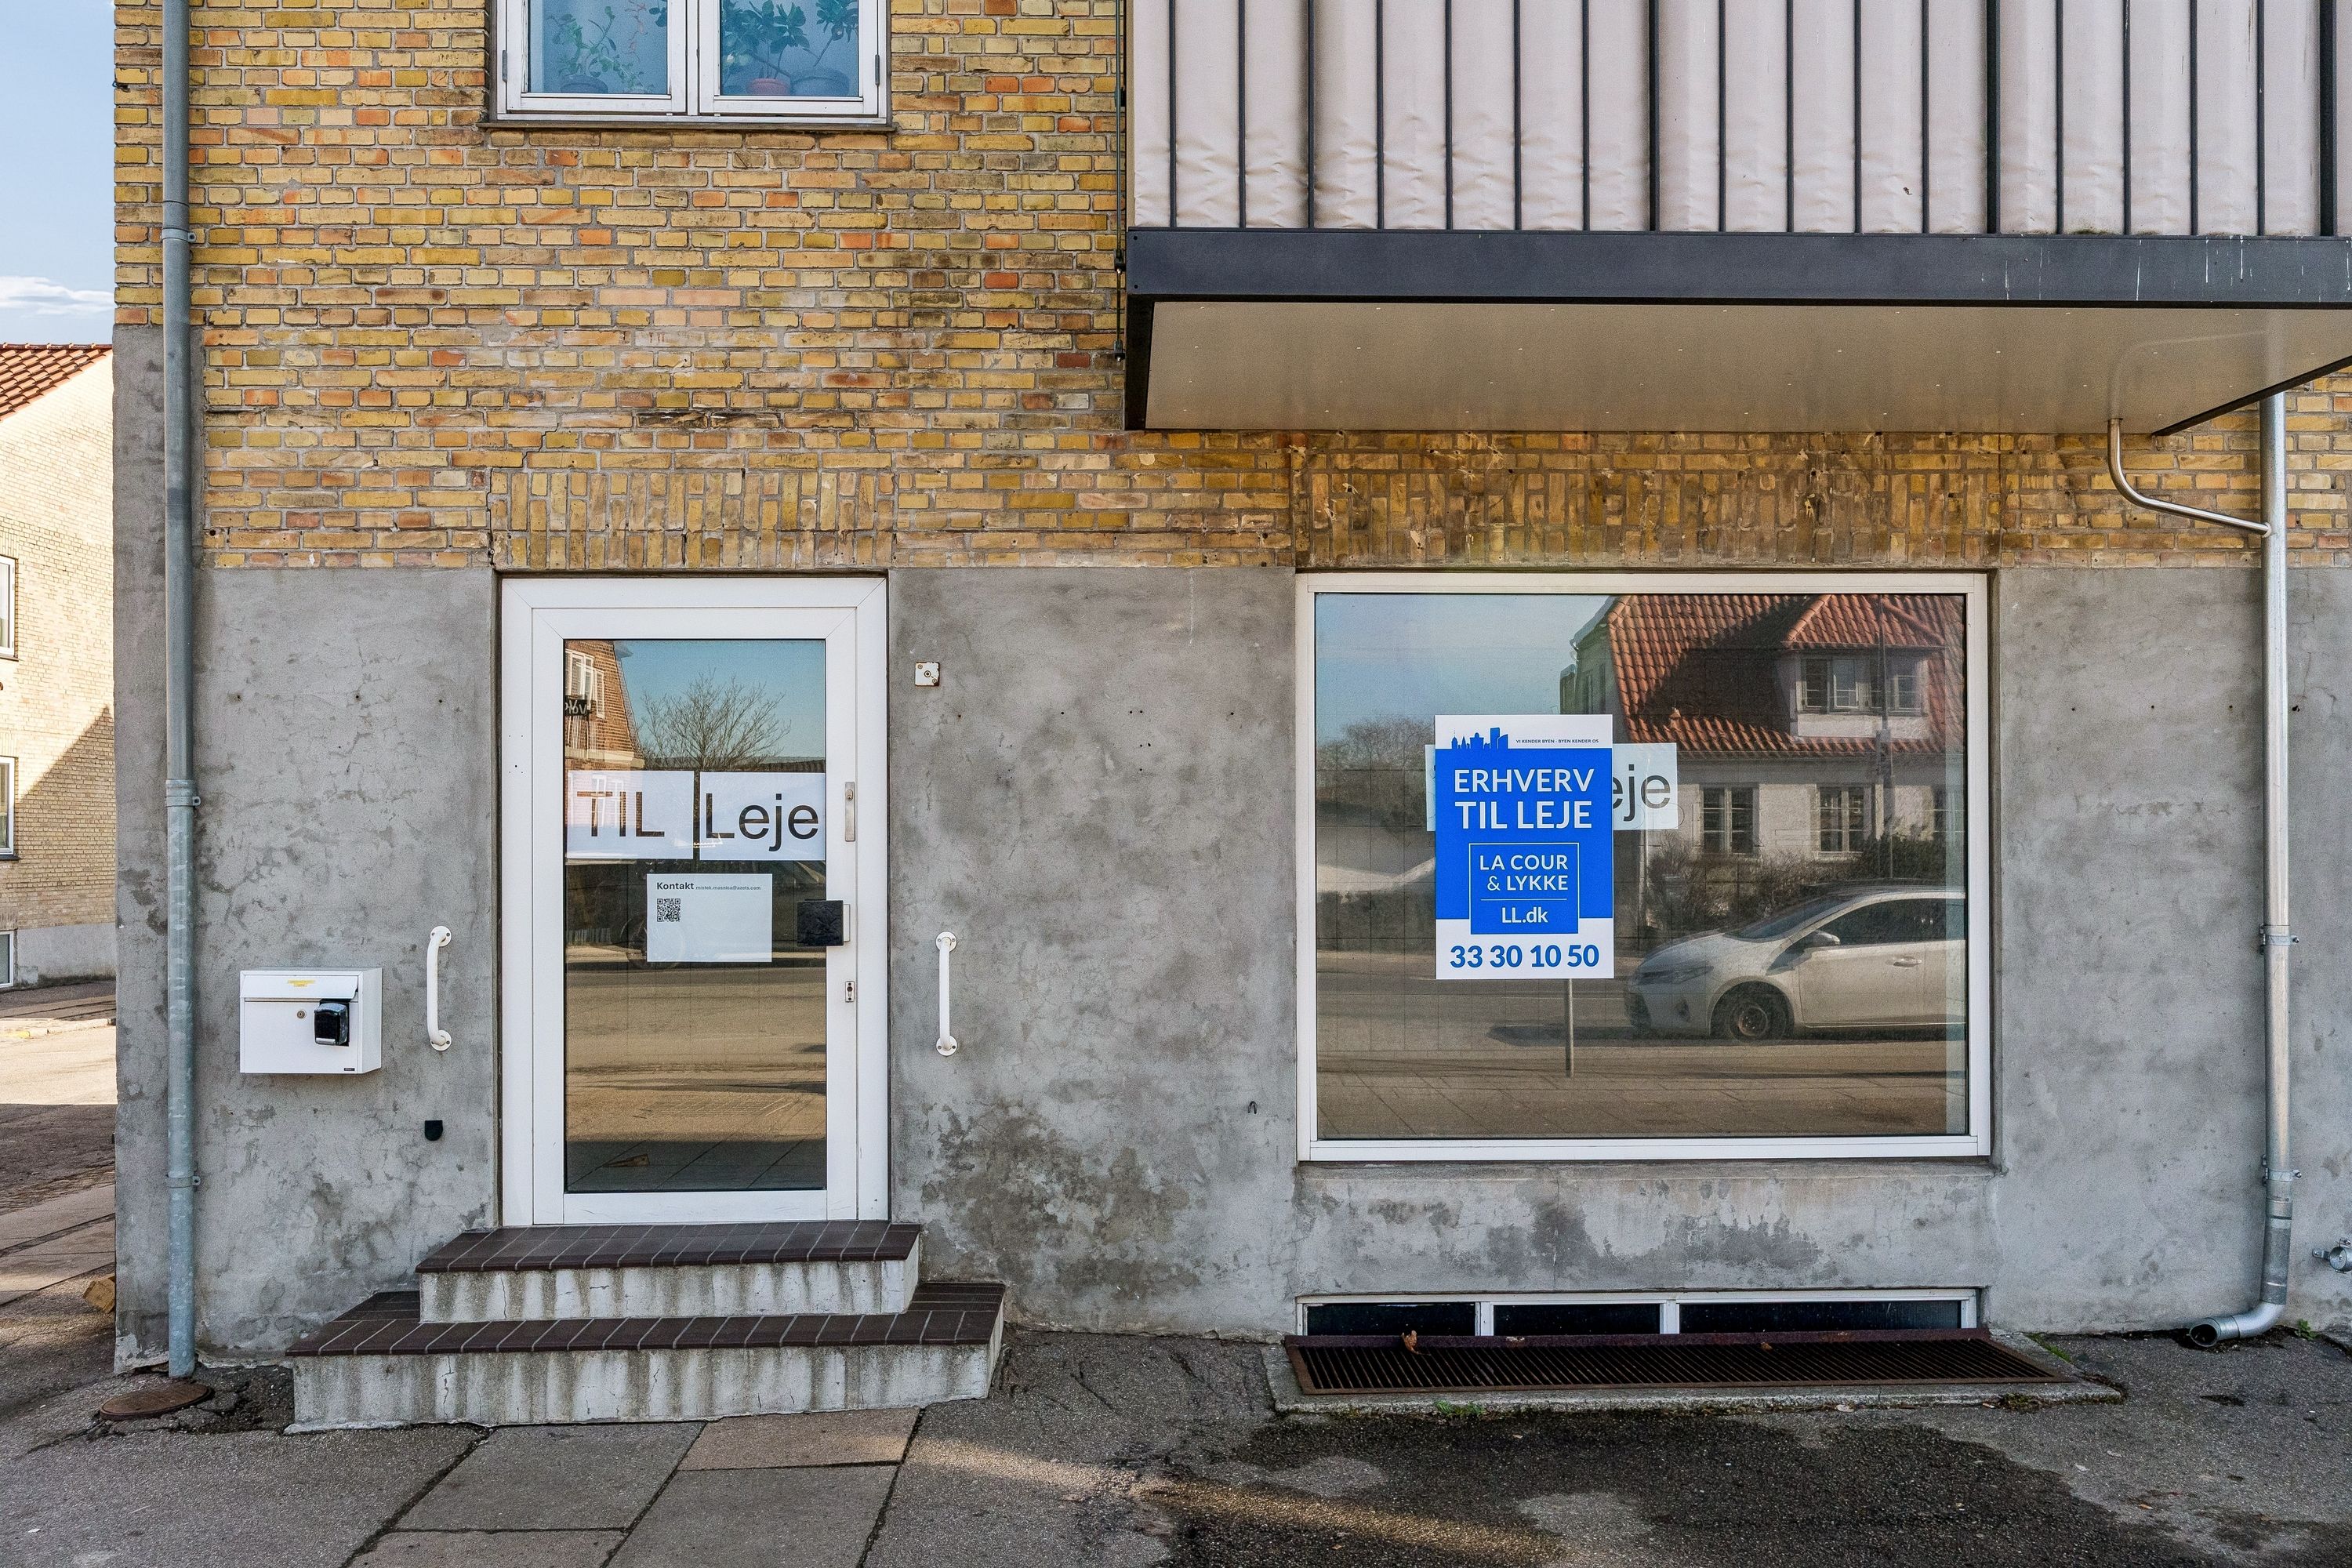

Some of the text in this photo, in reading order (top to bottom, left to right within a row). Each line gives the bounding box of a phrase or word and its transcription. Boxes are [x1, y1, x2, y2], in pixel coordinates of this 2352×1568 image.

[1454, 768, 1595, 793] ERHVERV
[576, 791, 819, 852] TIL Leje
[1454, 800, 1592, 829] TIL LEJE
[1479, 855, 1568, 871] LA COUR
[1486, 875, 1568, 891] & LYKKE
[1501, 906, 1548, 924] LL.dk
[1450, 944, 1599, 968] 33 30 10 50
